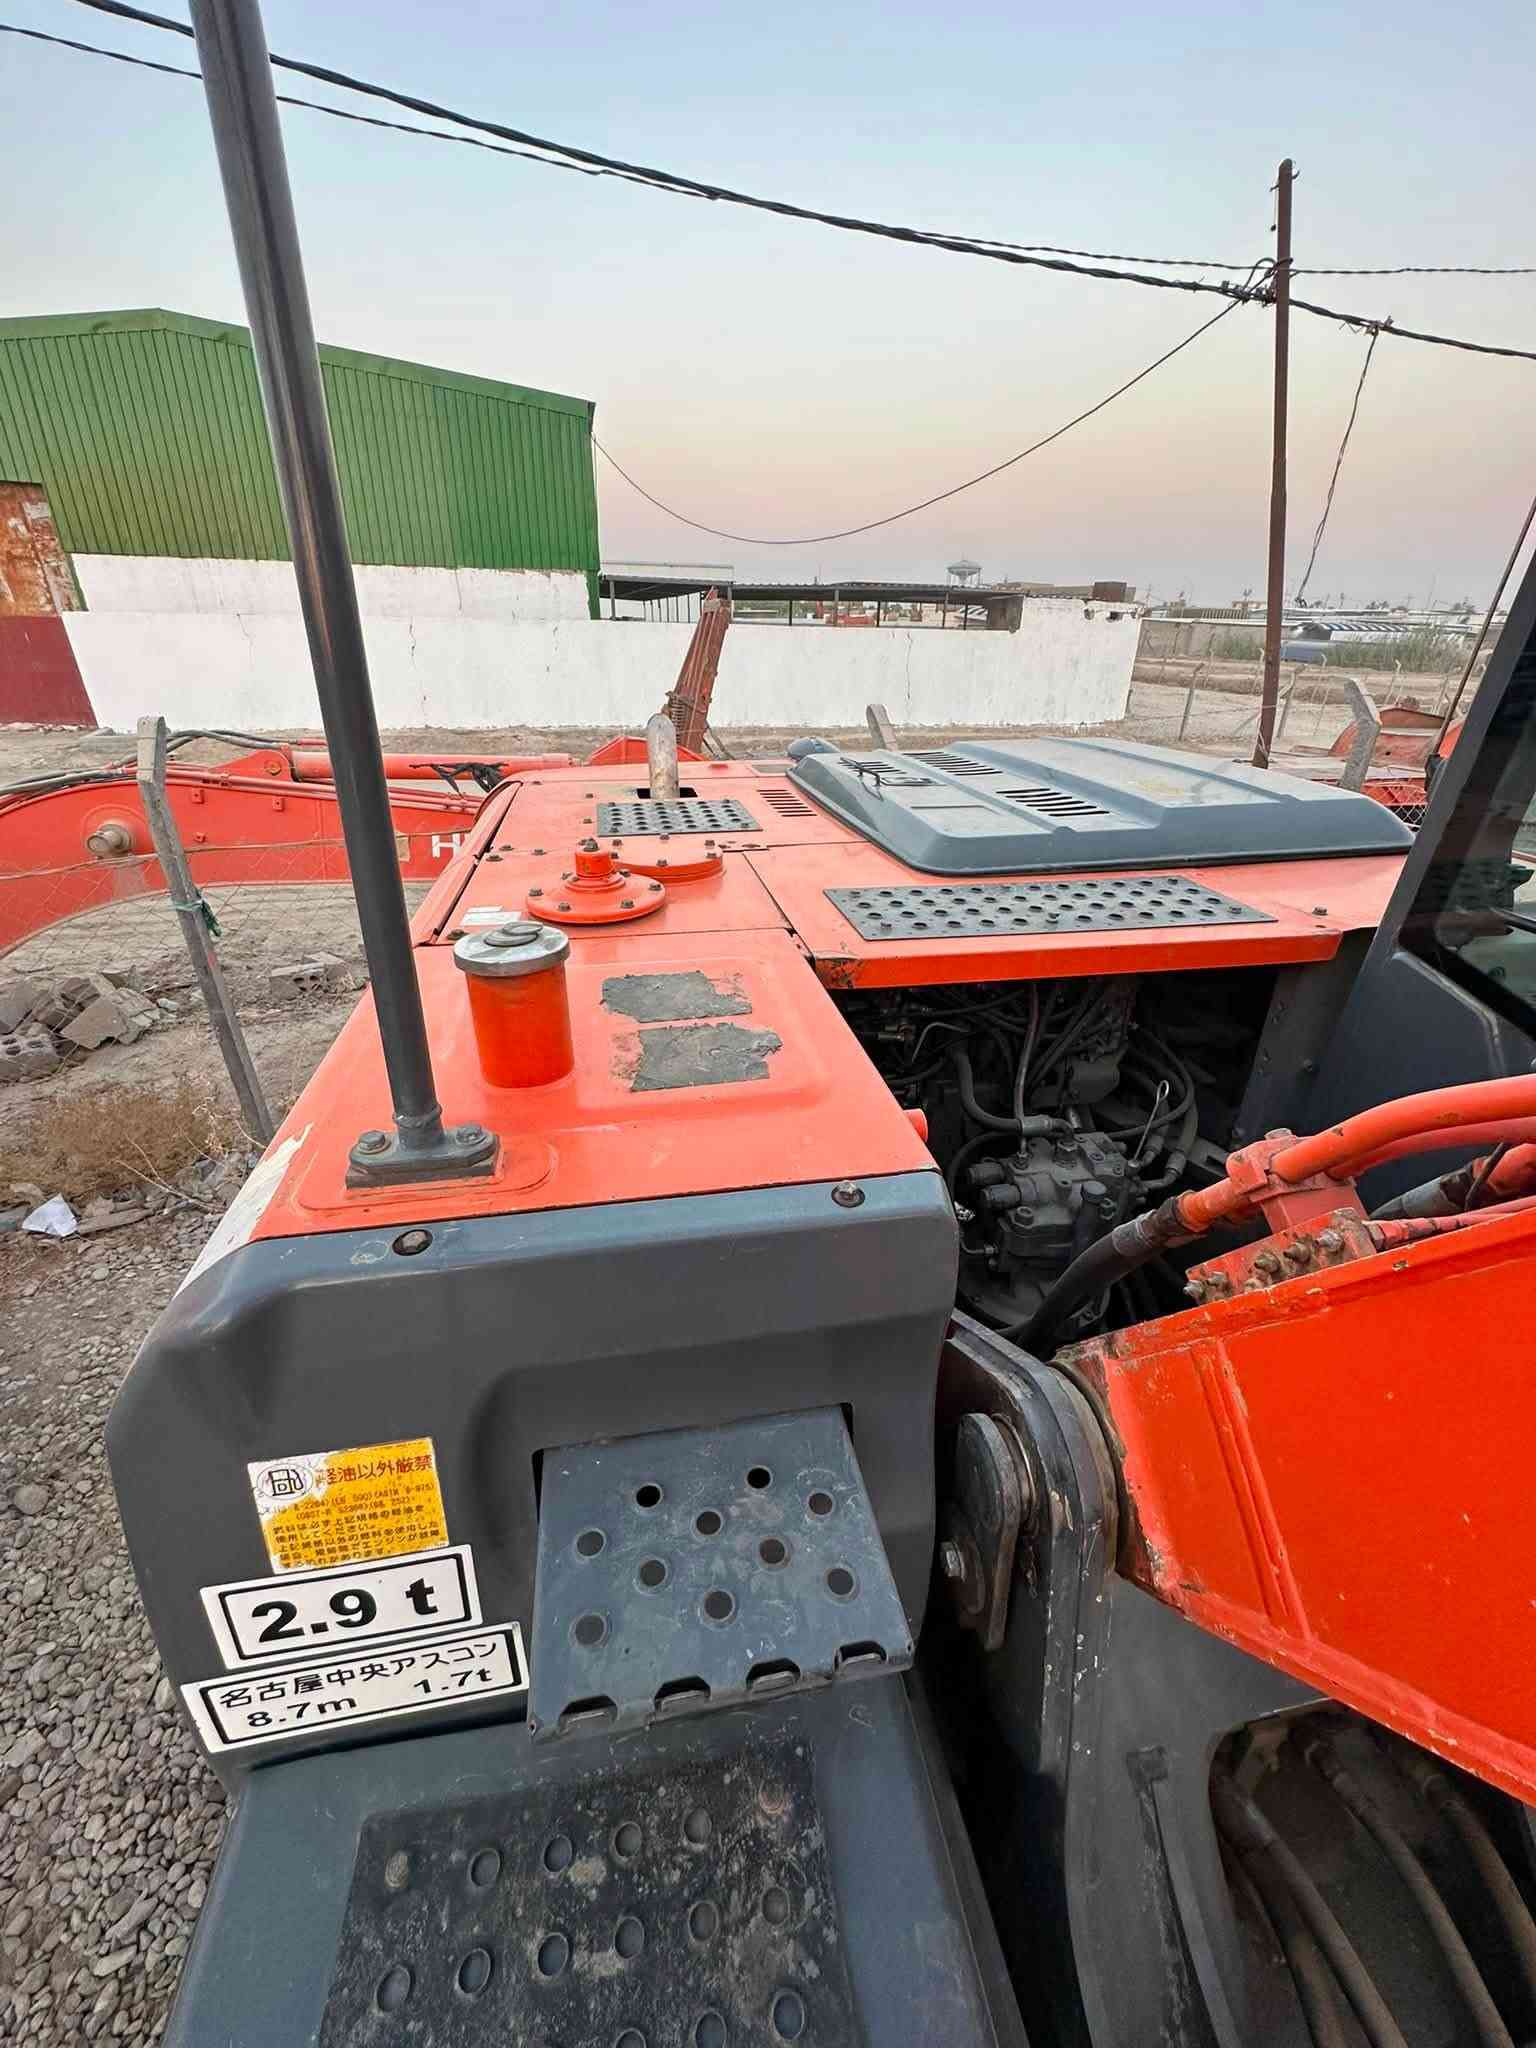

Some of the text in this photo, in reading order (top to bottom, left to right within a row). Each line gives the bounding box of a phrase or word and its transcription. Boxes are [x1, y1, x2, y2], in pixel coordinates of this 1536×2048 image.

[251, 1578, 439, 1643] 2.9 t
[219, 1642, 497, 1709] 名古屋中央アスコン
[246, 1668, 493, 1728] 8.7m 1.7t
